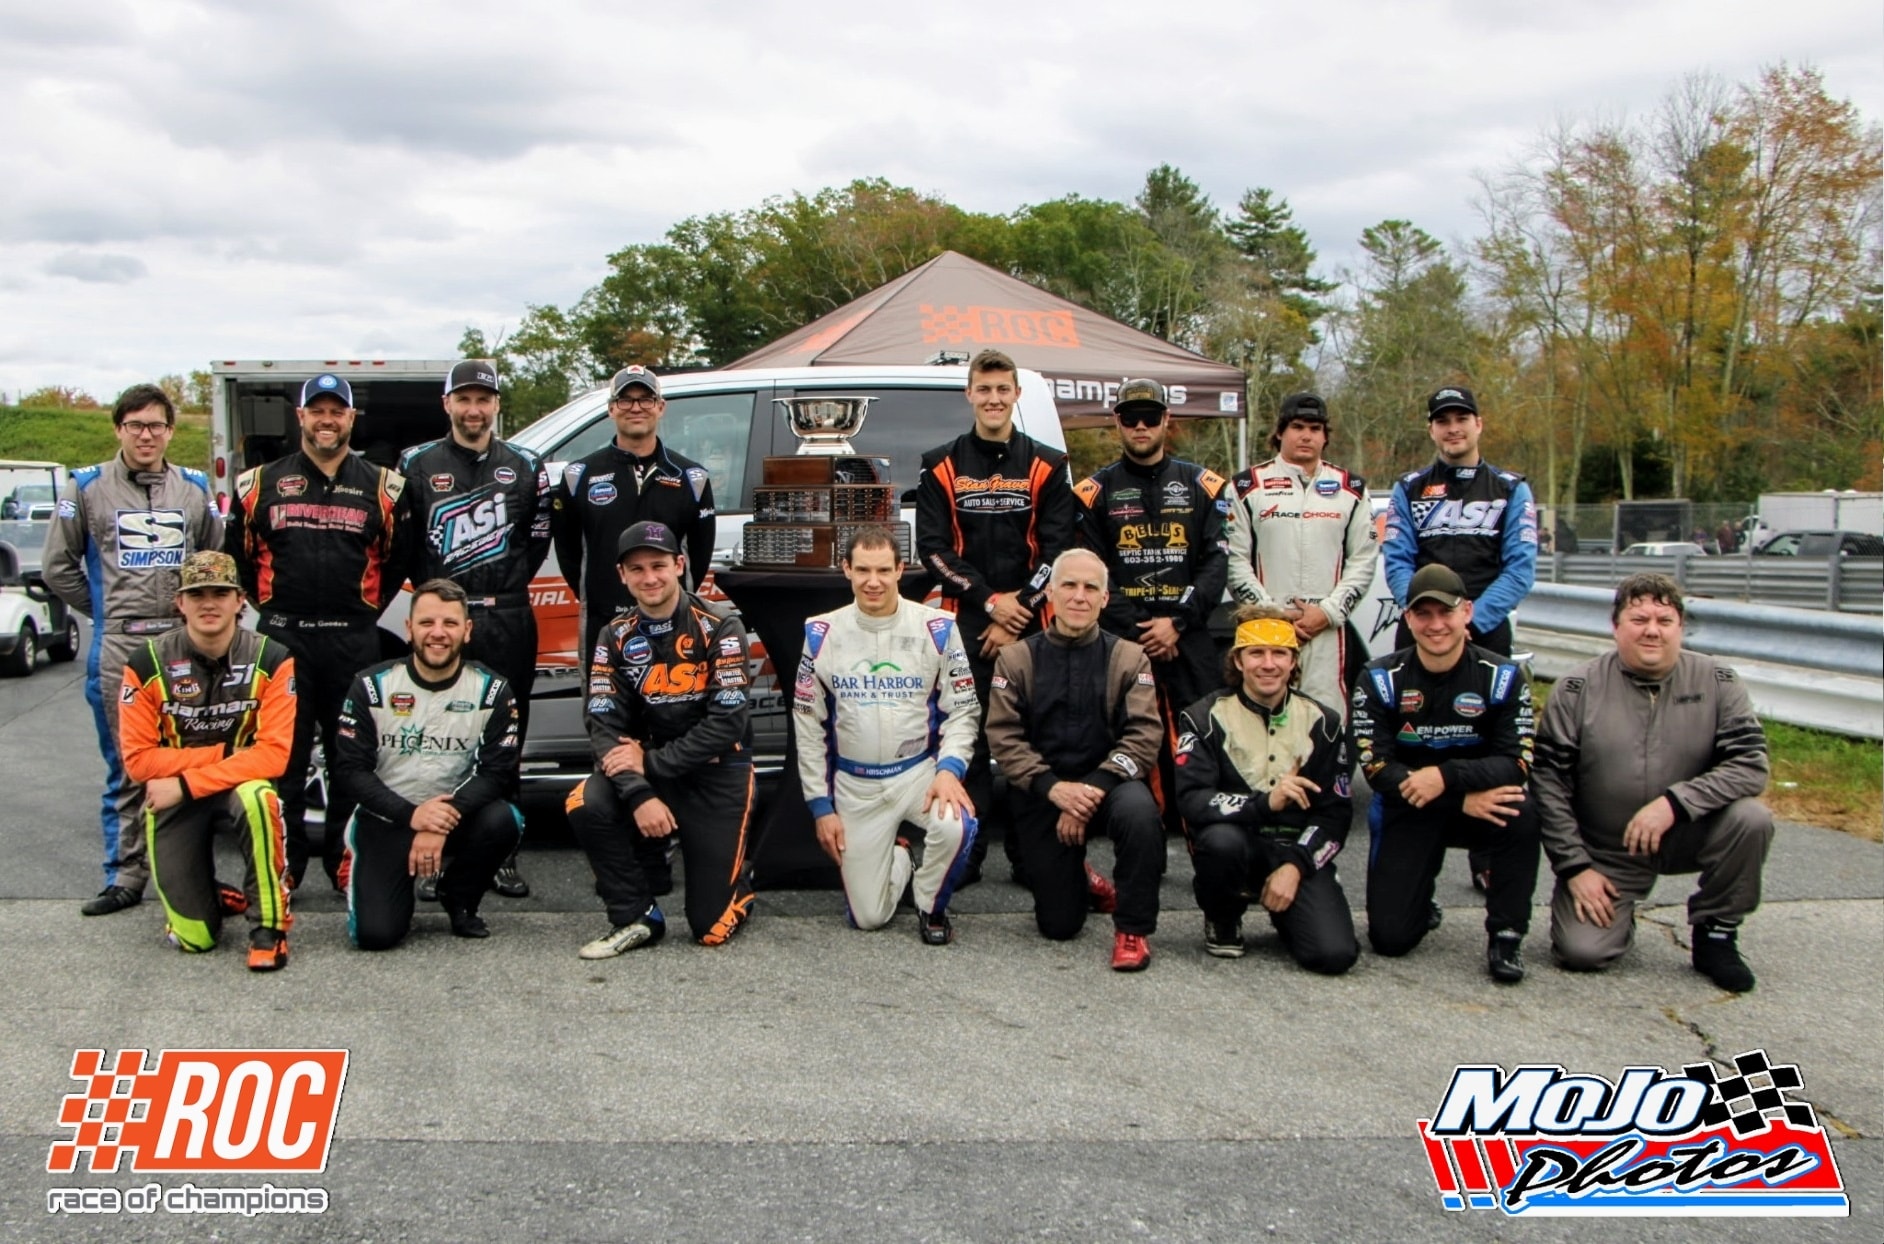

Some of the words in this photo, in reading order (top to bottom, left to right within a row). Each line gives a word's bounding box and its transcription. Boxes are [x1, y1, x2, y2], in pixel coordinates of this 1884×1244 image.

[979, 308, 1071, 345] ROC
[963, 498, 981, 507] AUTO
[1000, 498, 1025, 507] SERVICE
[1302, 511, 1341, 519] CHOICE
[120, 550, 183, 567] SIMPSON
[1119, 548, 1142, 557] SEPTIC
[1143, 548, 1162, 556] TANK
[1162, 548, 1188, 556] SERVICE
[174, 682, 201, 694] KING
[831, 674, 859, 690] BAR
[863, 674, 924, 690] HARBOR
[840, 691, 868, 699] BANK
[871, 691, 878, 699] &
[882, 691, 914, 699] TRUST
[161, 699, 259, 719] Harman
[183, 718, 236, 732] Racing
